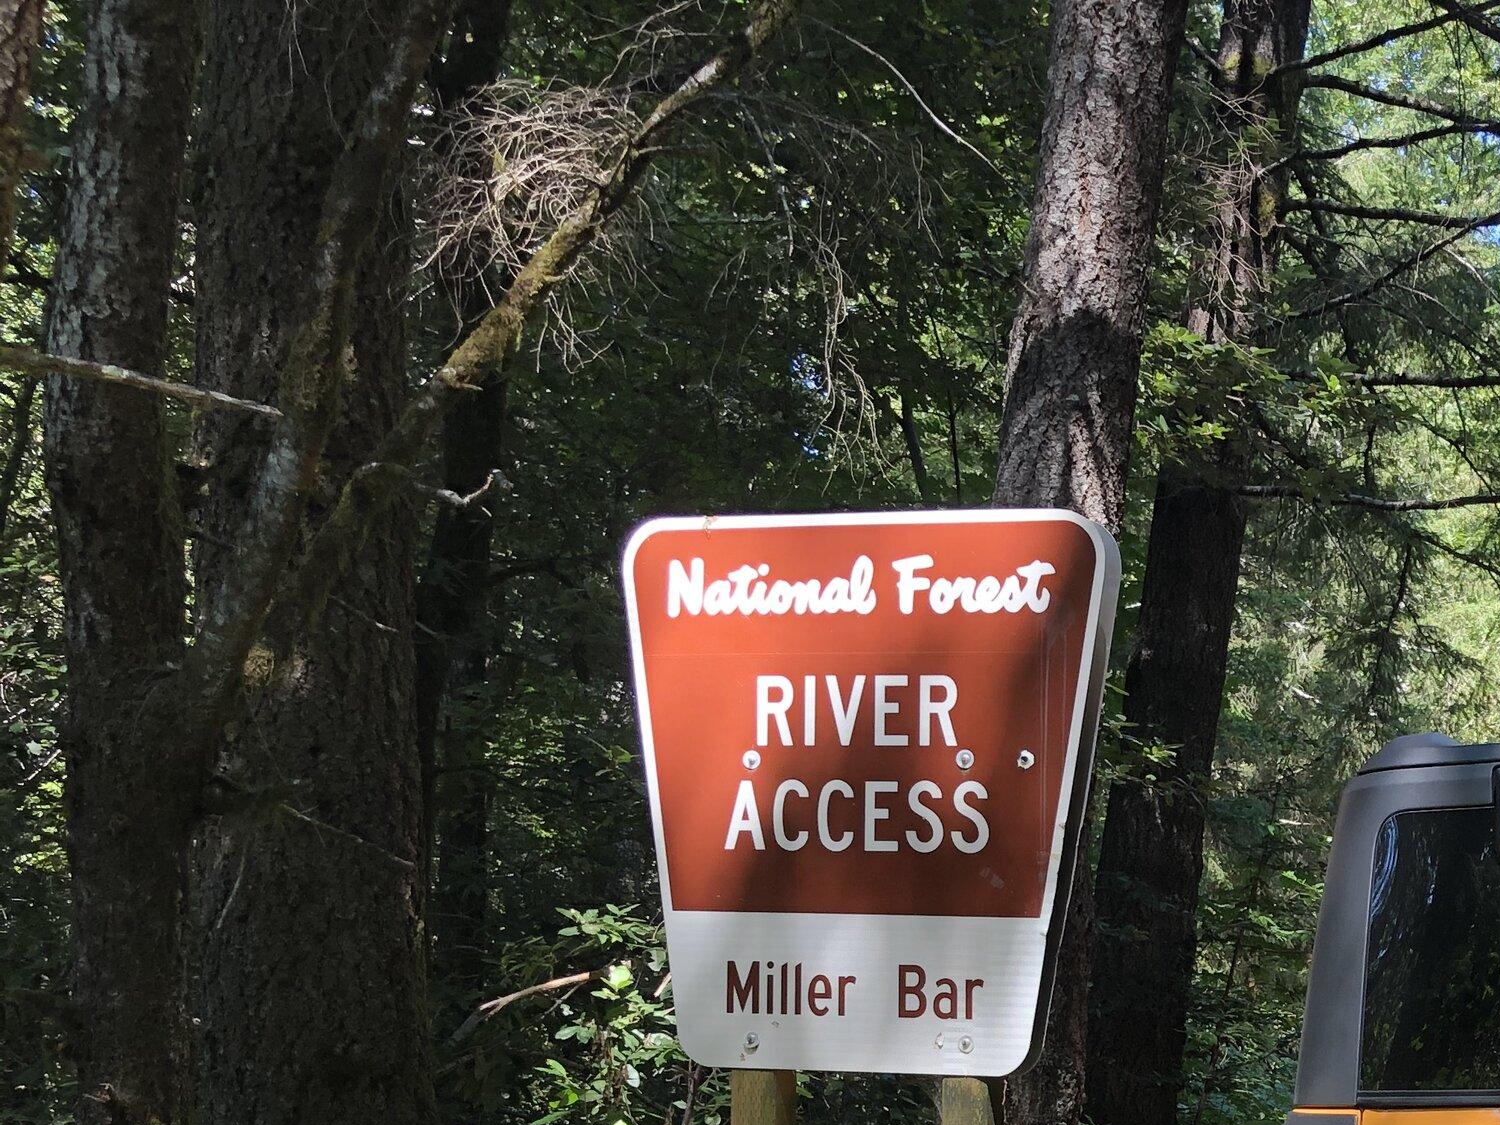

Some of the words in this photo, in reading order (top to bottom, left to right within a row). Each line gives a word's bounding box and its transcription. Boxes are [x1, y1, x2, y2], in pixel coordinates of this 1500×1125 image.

[667, 554, 877, 619] National
[891, 553, 1057, 615] Forest
[757, 674, 957, 747] RIVER
[724, 779, 990, 853] ACCESS
[725, 960, 857, 1017] Miller
[897, 964, 984, 1020] Bar
